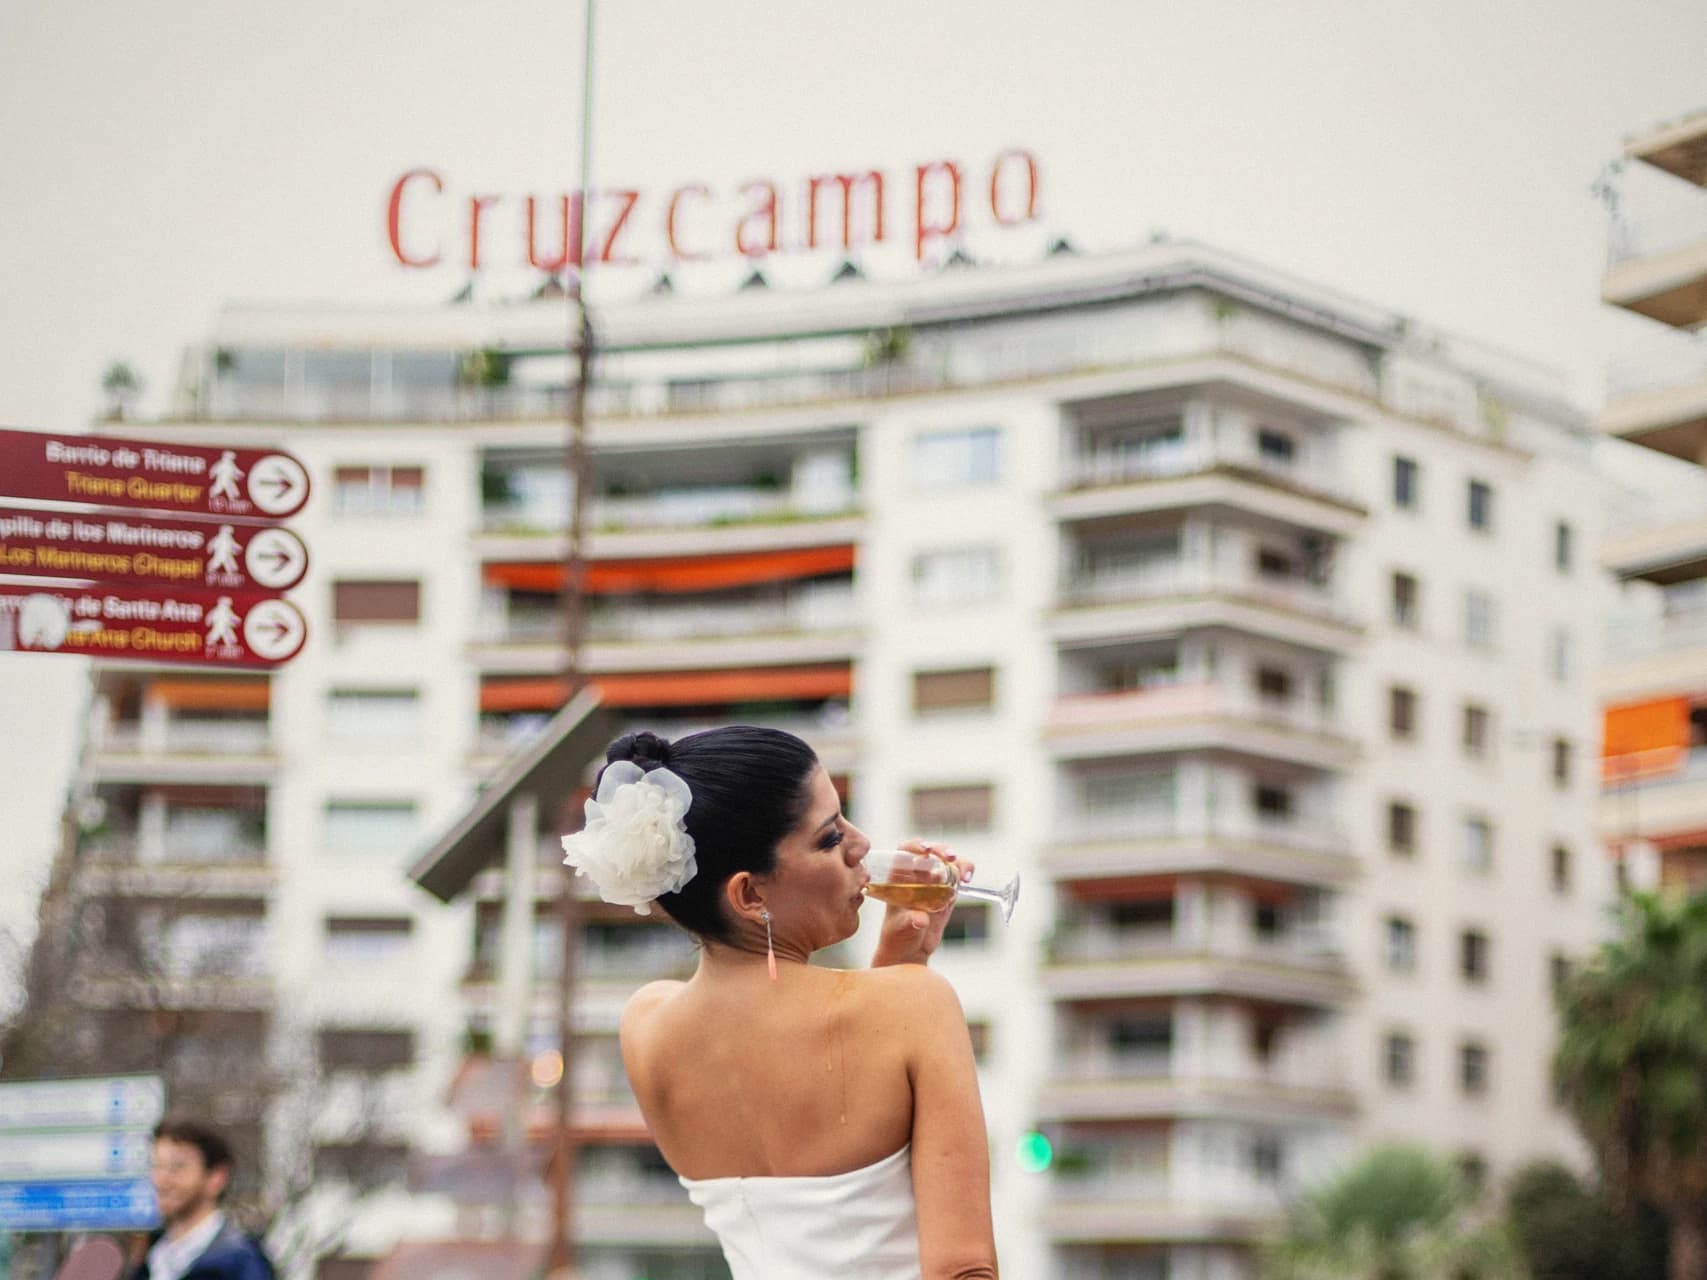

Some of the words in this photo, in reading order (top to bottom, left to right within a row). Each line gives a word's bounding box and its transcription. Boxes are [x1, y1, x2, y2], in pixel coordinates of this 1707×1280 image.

[386, 148, 1040, 272] Cruzcampo
[46, 441, 111, 467] Barrio
[112, 447, 140, 468] de
[141, 448, 206, 475] Triana
[65, 470, 126, 497] Triana
[127, 477, 203, 503] Quarter
[0, 515, 44, 538] pilla
[45, 518, 72, 540] de
[73, 519, 105, 542] los
[106, 521, 204, 549] Marineros
[0, 543, 34, 566] Los
[36, 546, 132, 573] Marineros
[133, 552, 203, 579] Chapel
[75, 595, 101, 617] de
[103, 596, 161, 621] Santa
[162, 599, 203, 622] Ana
[131, 627, 202, 651] Church
